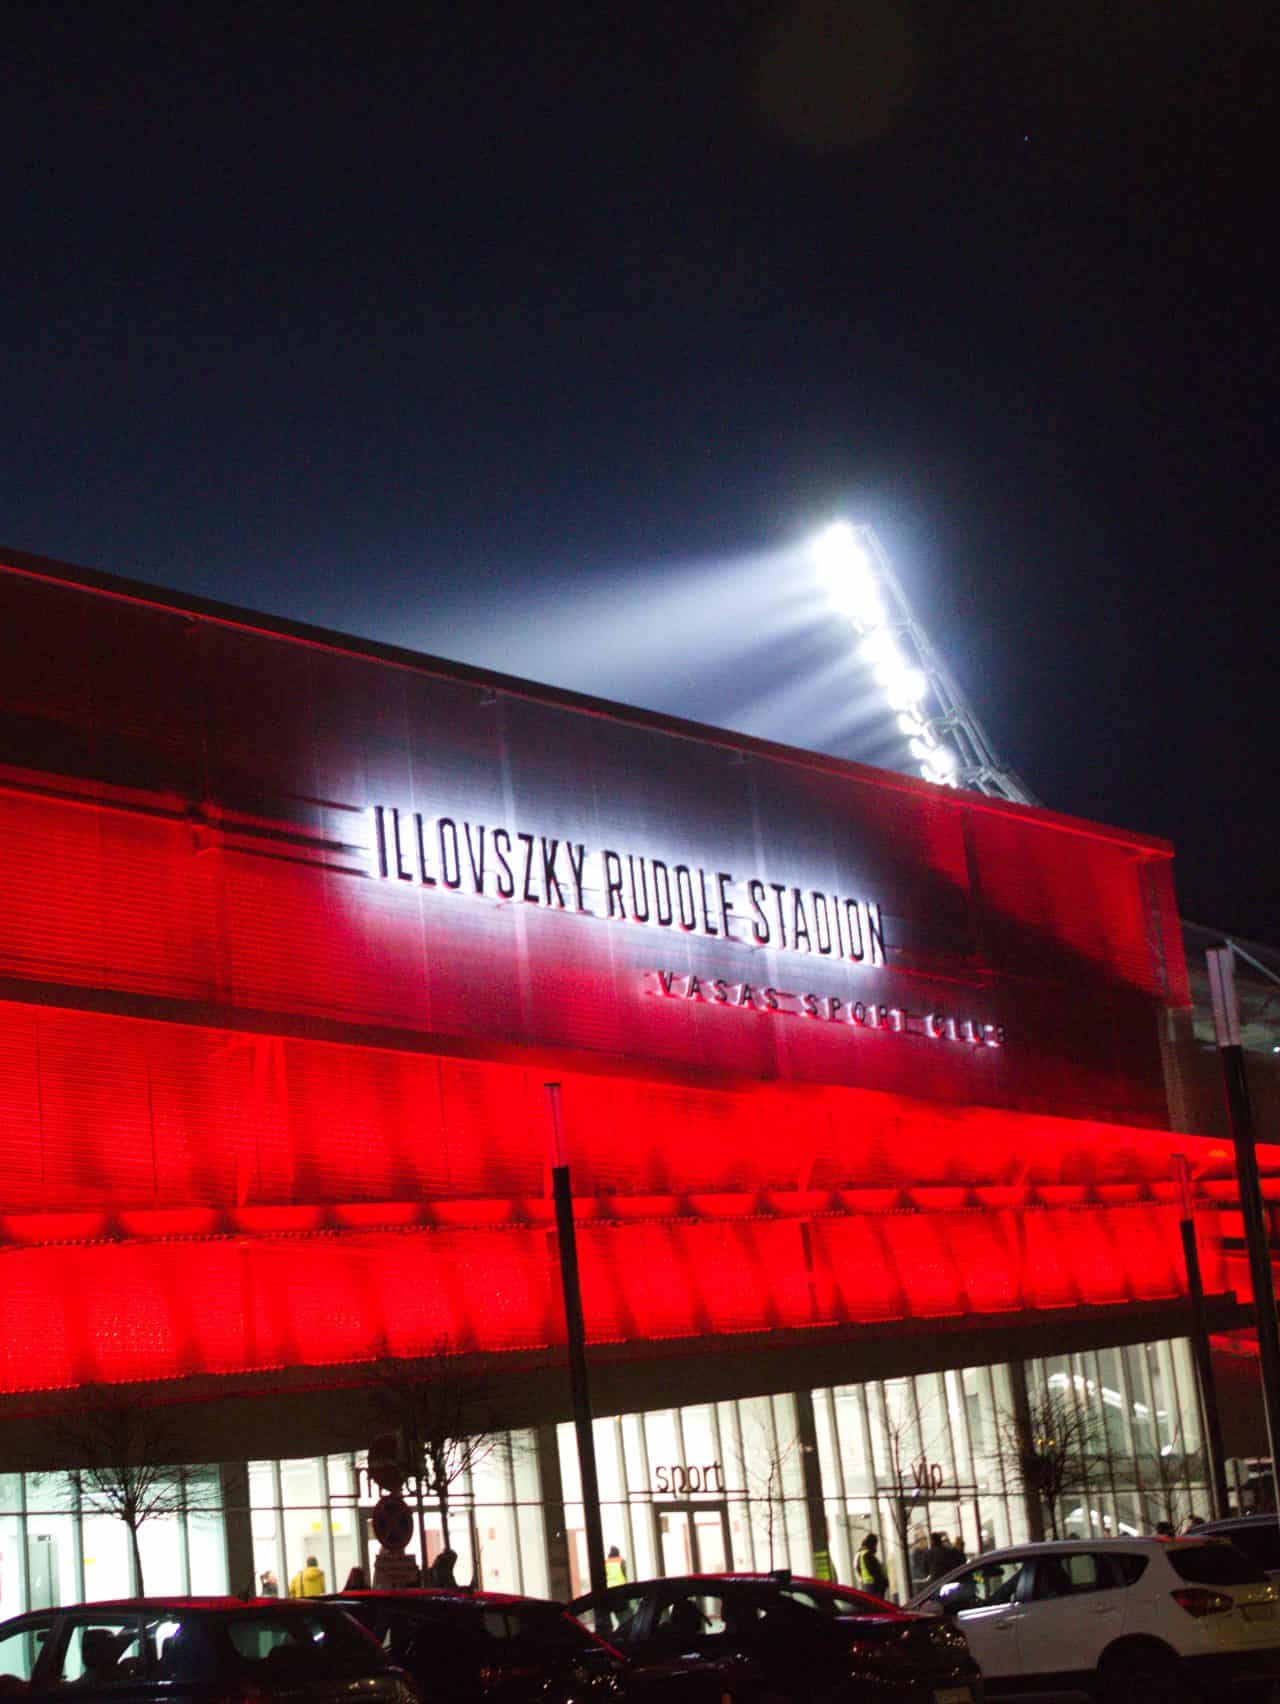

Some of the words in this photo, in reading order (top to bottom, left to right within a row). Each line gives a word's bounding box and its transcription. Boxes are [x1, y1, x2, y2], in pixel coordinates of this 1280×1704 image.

[374, 804, 586, 912] ILLOVSZKY
[602, 848, 734, 937] RUDOLF
[747, 878, 887, 965] STADION
[657, 969, 779, 1010] VASAS
[799, 993, 908, 1031] SPORT
[655, 1461, 724, 1499] sport
